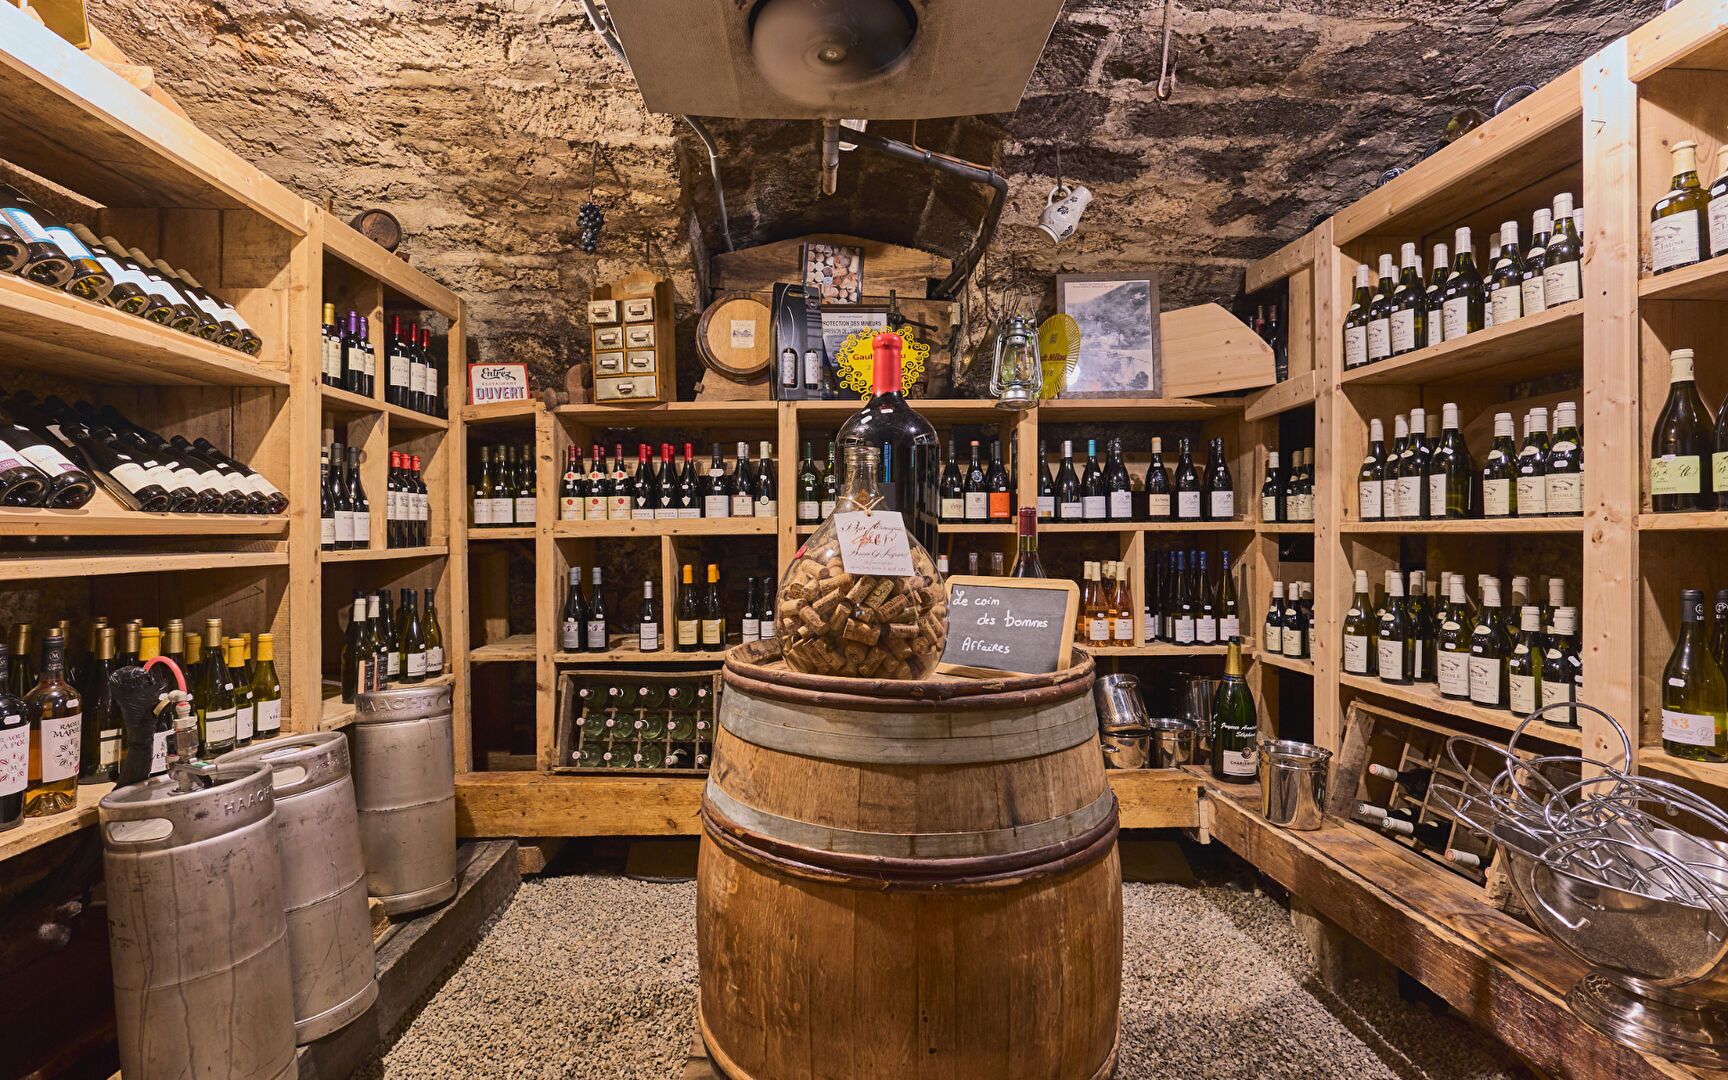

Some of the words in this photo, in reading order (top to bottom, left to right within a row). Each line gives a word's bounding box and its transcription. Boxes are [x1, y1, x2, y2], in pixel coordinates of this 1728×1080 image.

[481, 367, 516, 380] Entrez
[1042, 369, 1054, 377] 018
[475, 386, 525, 400] OUVERT
[952, 590, 969, 607] Le
[974, 596, 1000, 606] coin
[976, 613, 996, 625] des
